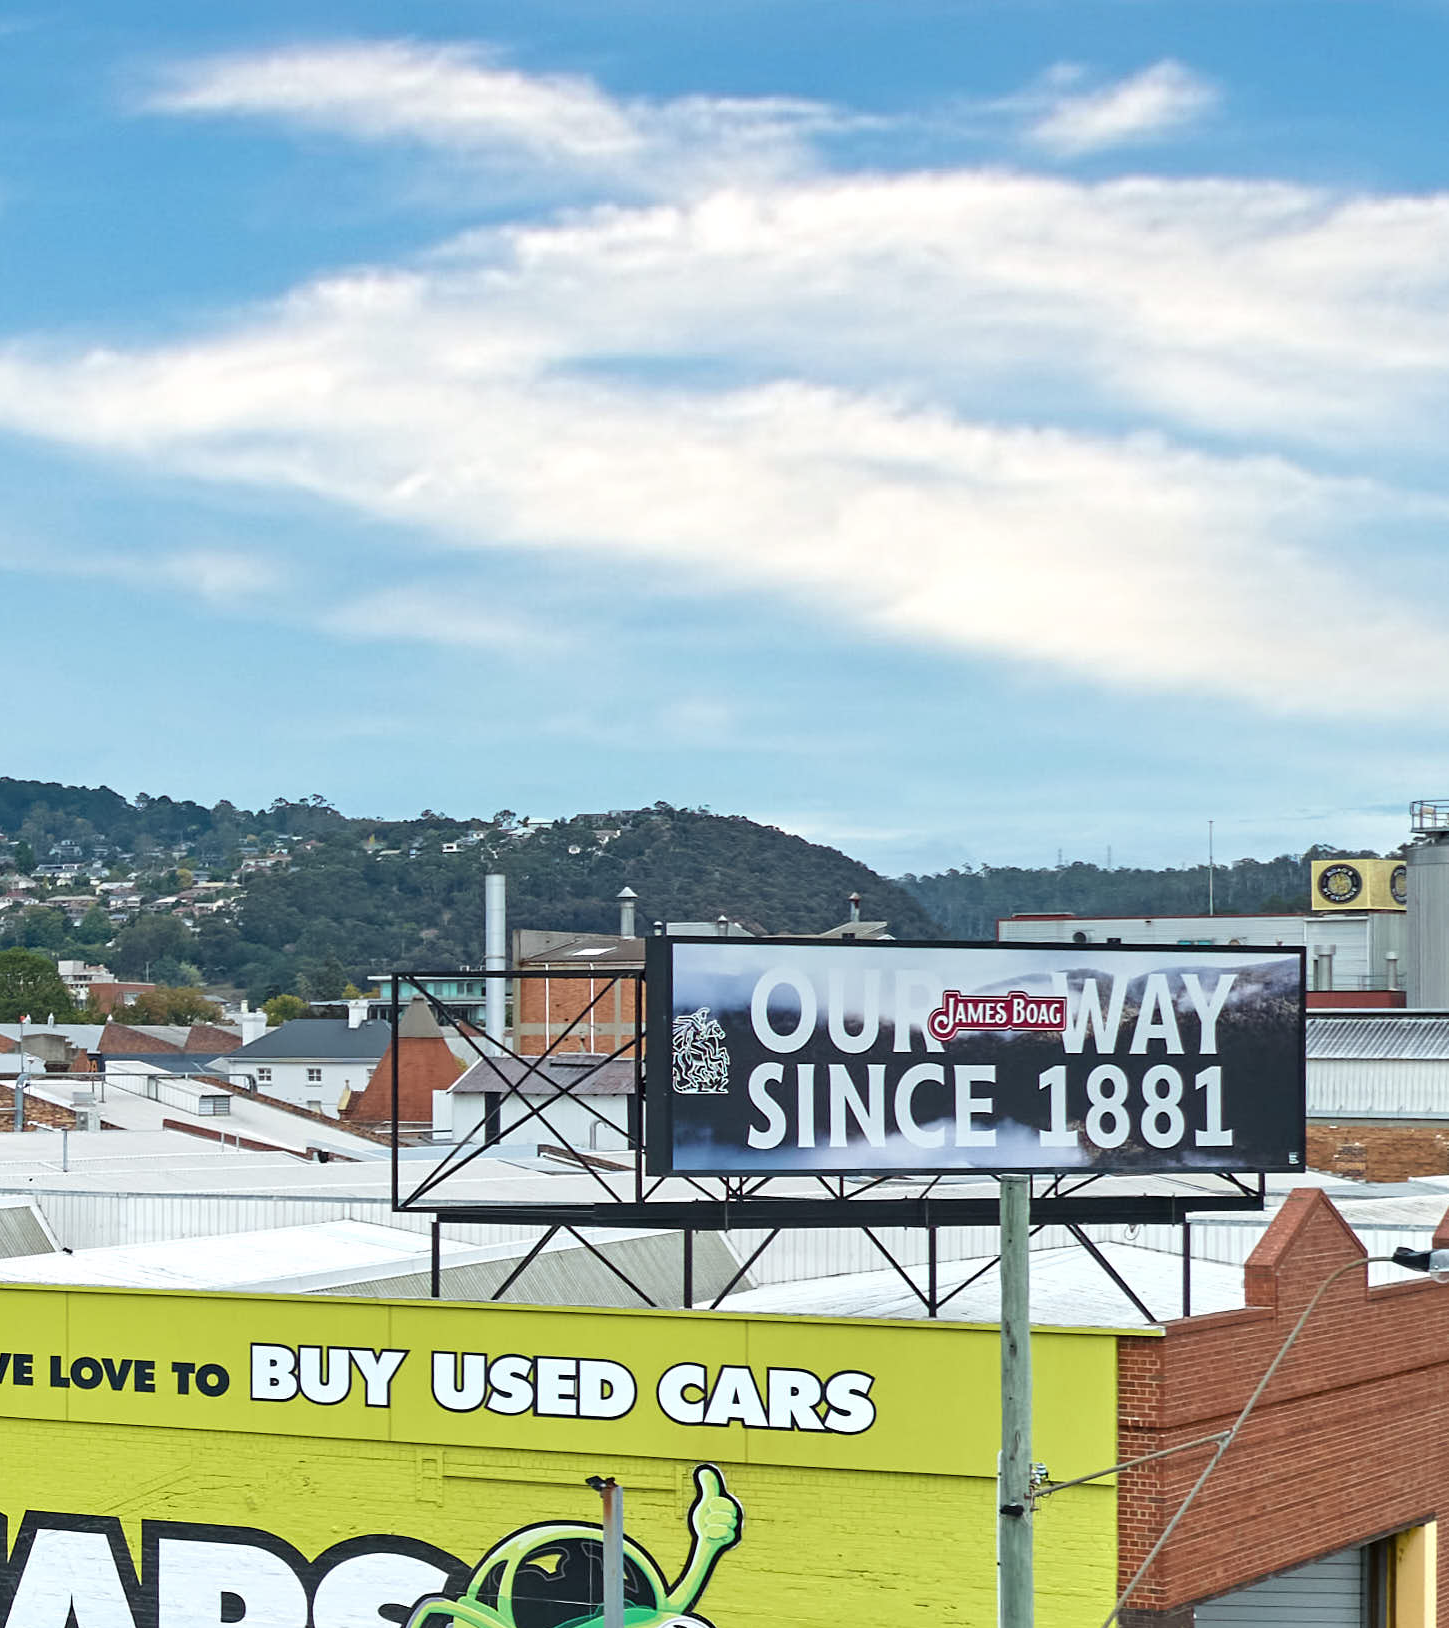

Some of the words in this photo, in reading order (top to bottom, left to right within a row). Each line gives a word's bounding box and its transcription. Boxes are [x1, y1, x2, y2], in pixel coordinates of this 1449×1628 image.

[748, 966, 946, 1055] OUR
[1051, 971, 1240, 1056] WAY
[933, 998, 1007, 1034] JAMES
[1011, 998, 1061, 1024] BOAG
[747, 1063, 999, 1150] SINCE
[1038, 1063, 1234, 1150] 1881
[49, 1355, 156, 1393] LOVE
[171, 1361, 231, 1398] TO
[248, 1342, 410, 1408] BUY
[430, 1350, 637, 1421] USED
[656, 1361, 877, 1436] CARS
